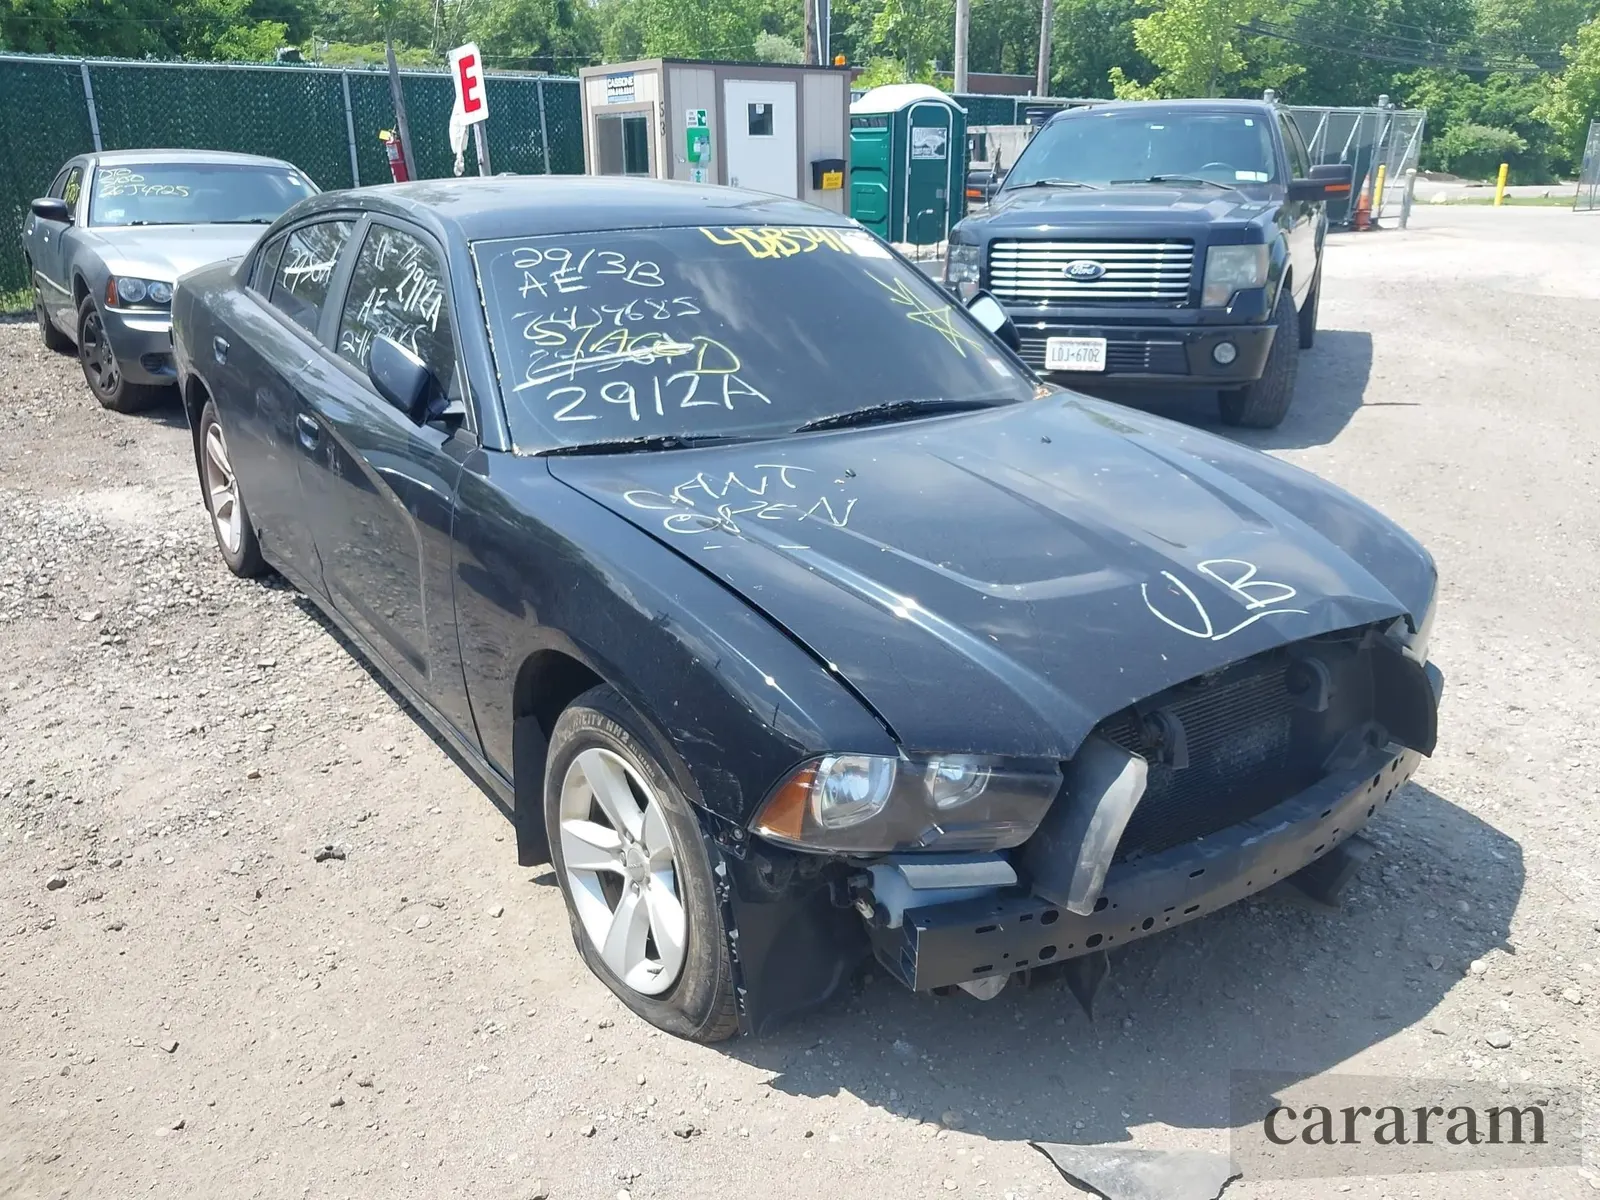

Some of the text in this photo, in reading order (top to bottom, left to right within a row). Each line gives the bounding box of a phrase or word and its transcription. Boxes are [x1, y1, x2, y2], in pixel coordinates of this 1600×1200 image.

[459, 54, 481, 113] E
[512, 248, 665, 287] 2913B
[518, 267, 591, 298] AE
[546, 372, 772, 421] 2912A
